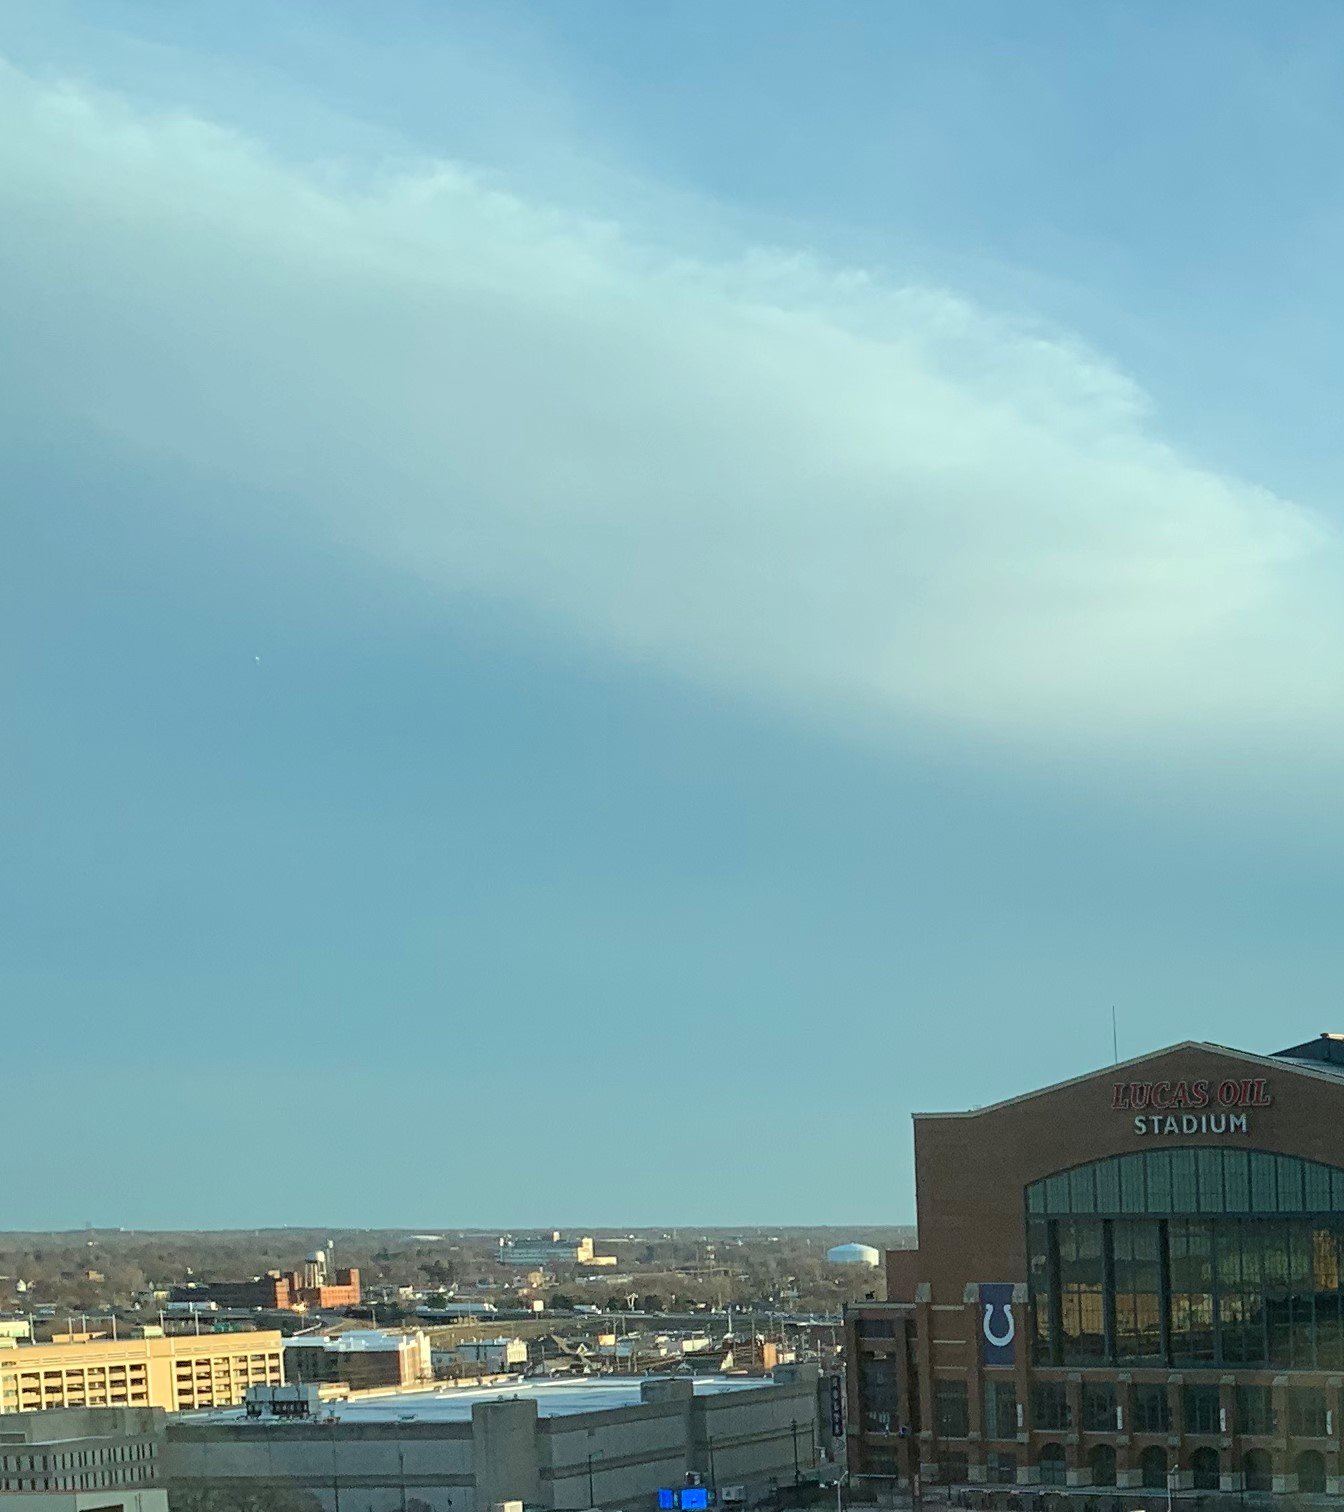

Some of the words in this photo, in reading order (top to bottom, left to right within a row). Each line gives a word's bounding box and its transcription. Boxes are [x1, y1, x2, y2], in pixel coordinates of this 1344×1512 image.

[1111, 1079, 1209, 1110] LUCAS
[1217, 1078, 1271, 1107] OIL
[1134, 1112, 1248, 1136] STADIUM
